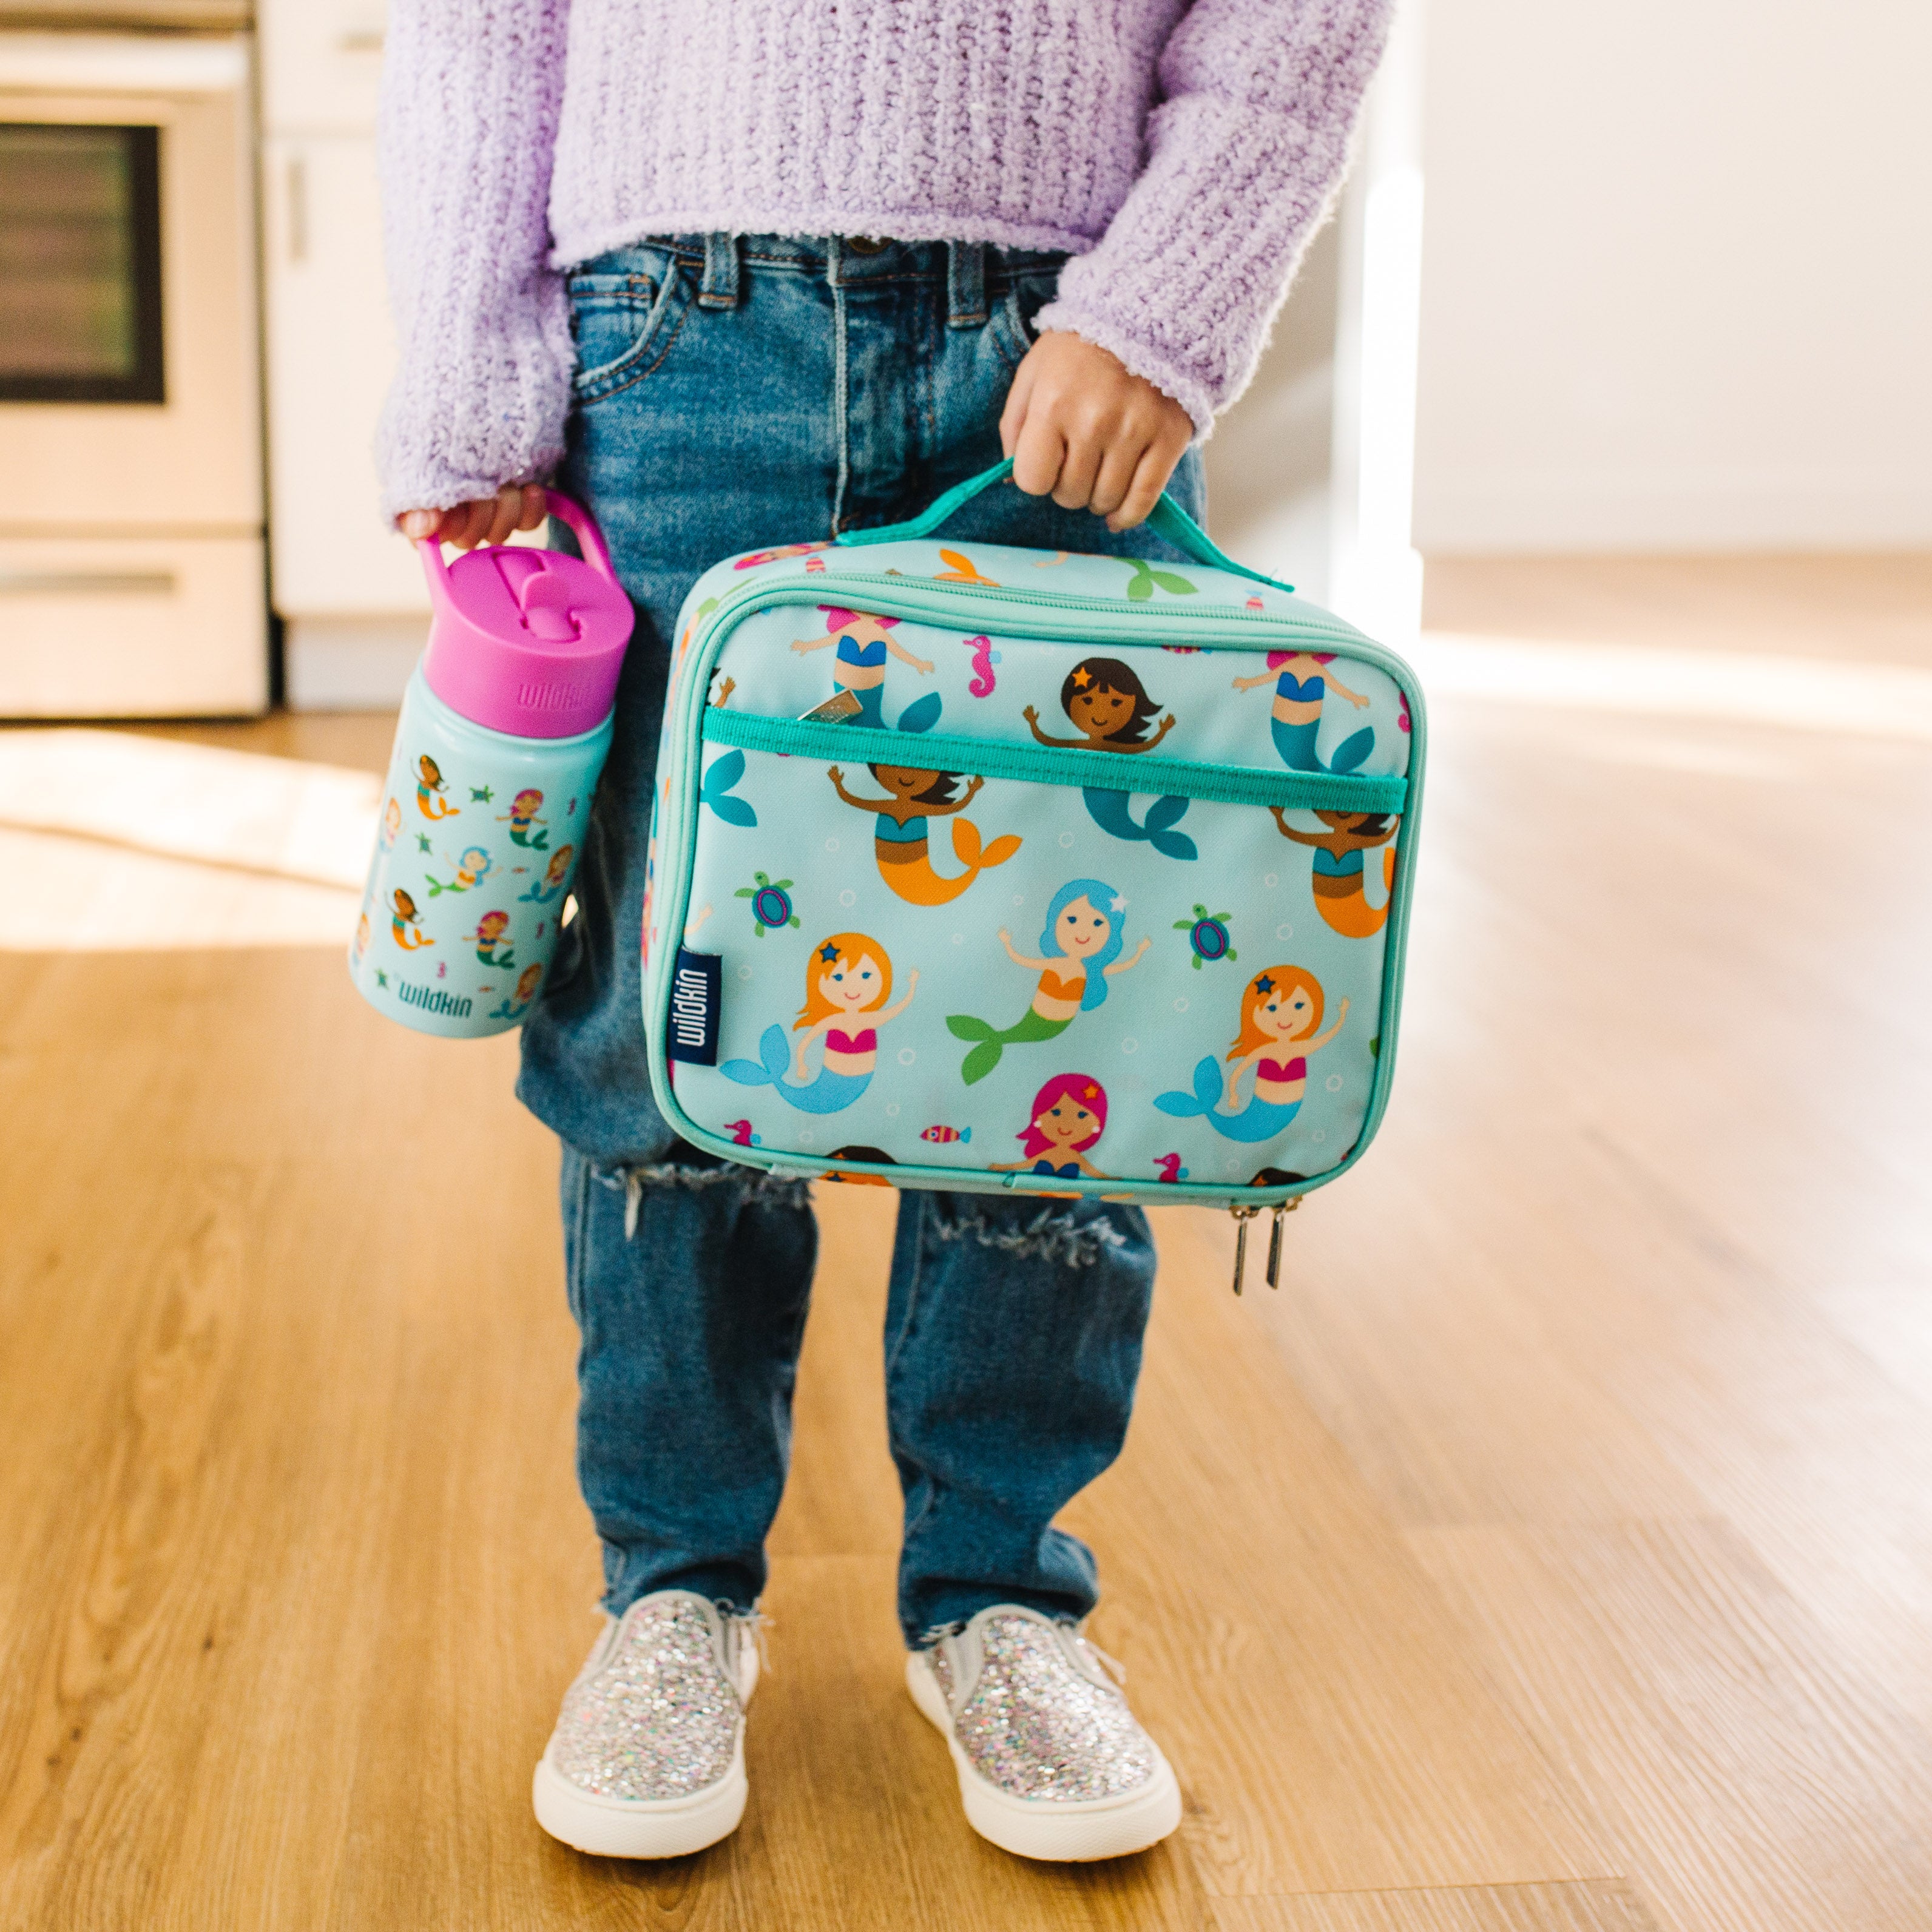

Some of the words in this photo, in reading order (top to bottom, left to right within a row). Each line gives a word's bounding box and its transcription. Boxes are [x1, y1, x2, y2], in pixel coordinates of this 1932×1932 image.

[517, 683, 584, 710] wildk
[399, 982, 473, 1018] wildkin
[672, 969, 707, 1047] wildkin
